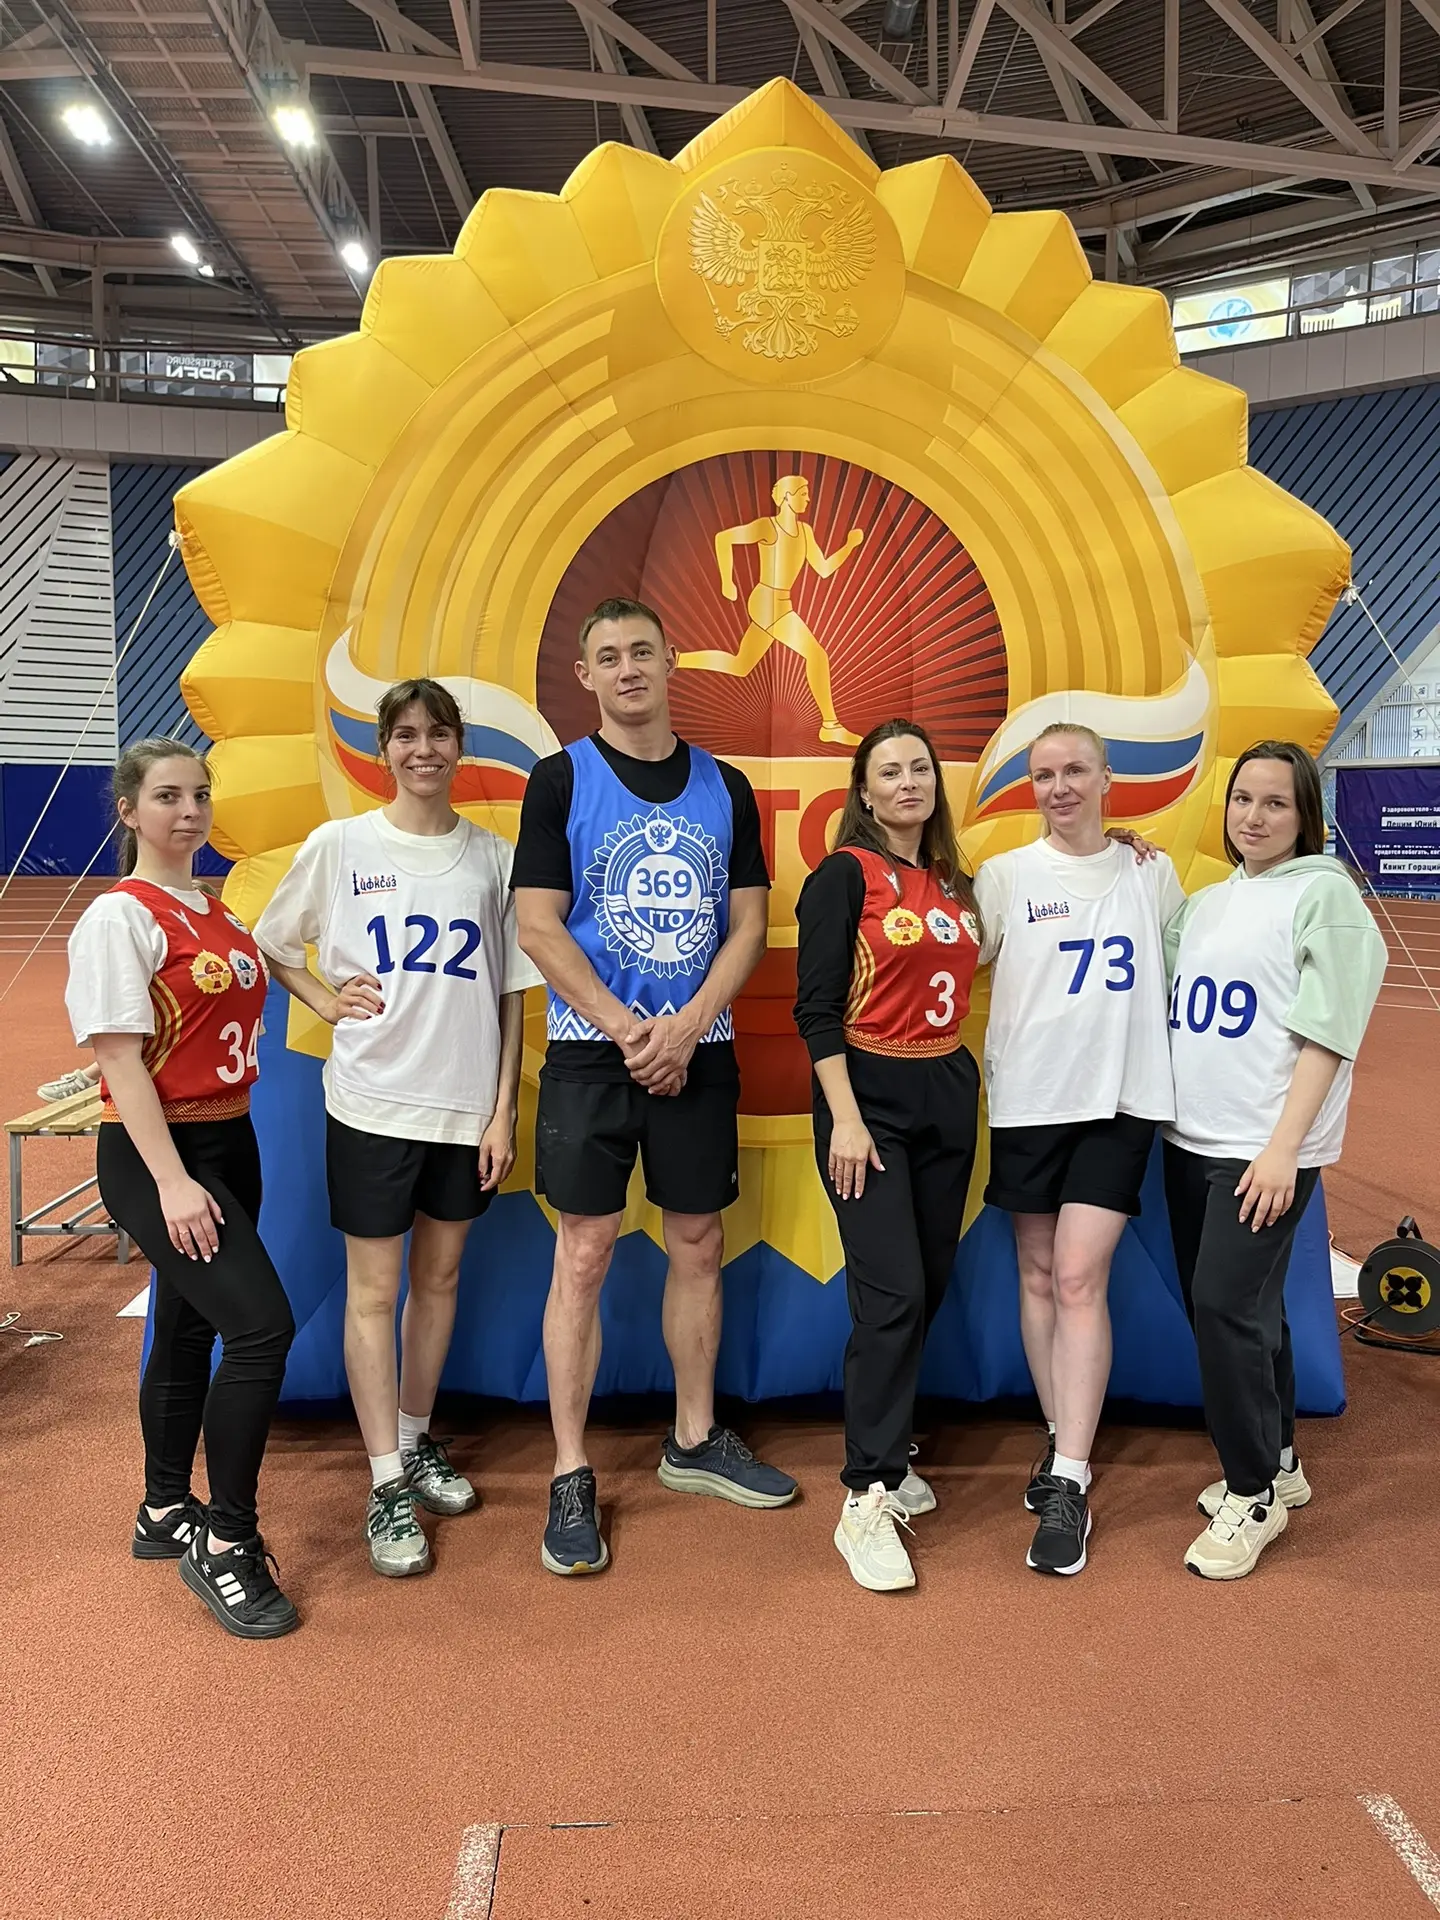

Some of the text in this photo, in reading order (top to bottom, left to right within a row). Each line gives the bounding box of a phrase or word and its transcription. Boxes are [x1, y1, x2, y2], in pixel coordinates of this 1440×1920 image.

[636, 867, 692, 898] 369
[366, 914, 482, 981] 122
[1058, 935, 1136, 995] 73
[925, 970, 956, 1027] 3
[1169, 974, 1258, 1039] 109
[216, 1017, 260, 1084] 34
